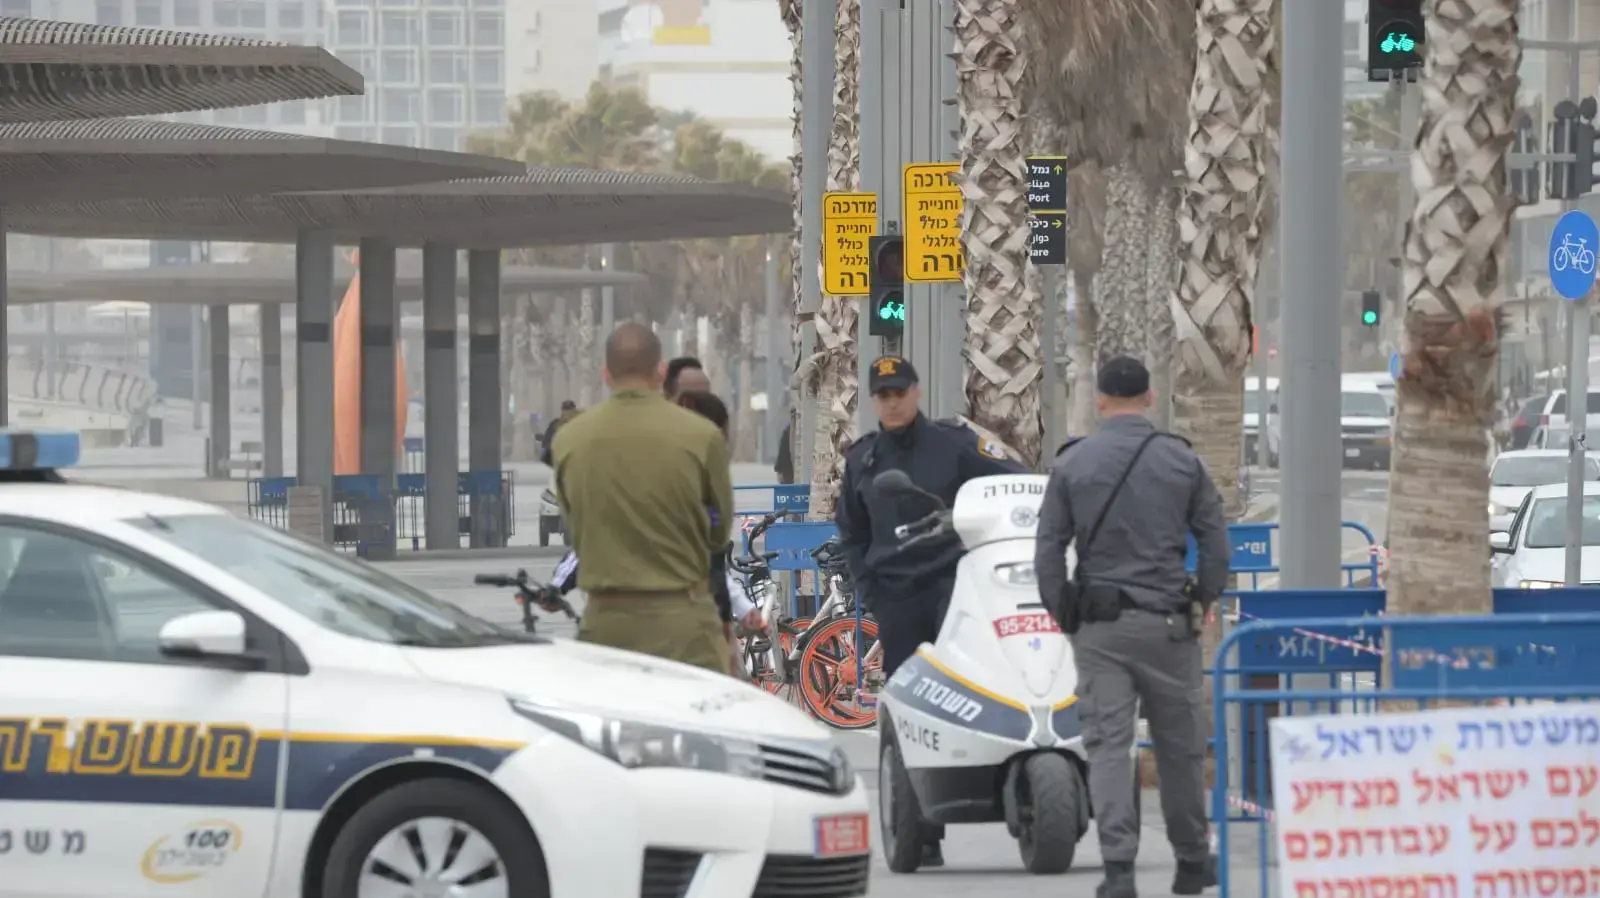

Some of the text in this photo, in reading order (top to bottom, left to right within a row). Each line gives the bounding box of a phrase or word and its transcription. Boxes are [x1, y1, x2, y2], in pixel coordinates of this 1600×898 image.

[918, 200, 959, 211] וחניית
[1028, 193, 1050, 202] Port
[832, 201, 876, 214] מדרכה
[836, 224, 872, 234] וחניית
[922, 234, 956, 247] גלגלי
[922, 254, 963, 272] ורה
[984, 483, 1044, 498] שטרה
[912, 677, 984, 722] משטרה
[1316, 716, 1600, 759] משטרת ישראל
[1291, 764, 1600, 813] עם ישראל מצדיע
[185, 829, 231, 848] 100
[1284, 811, 1600, 860] לכם על עבודתכם
